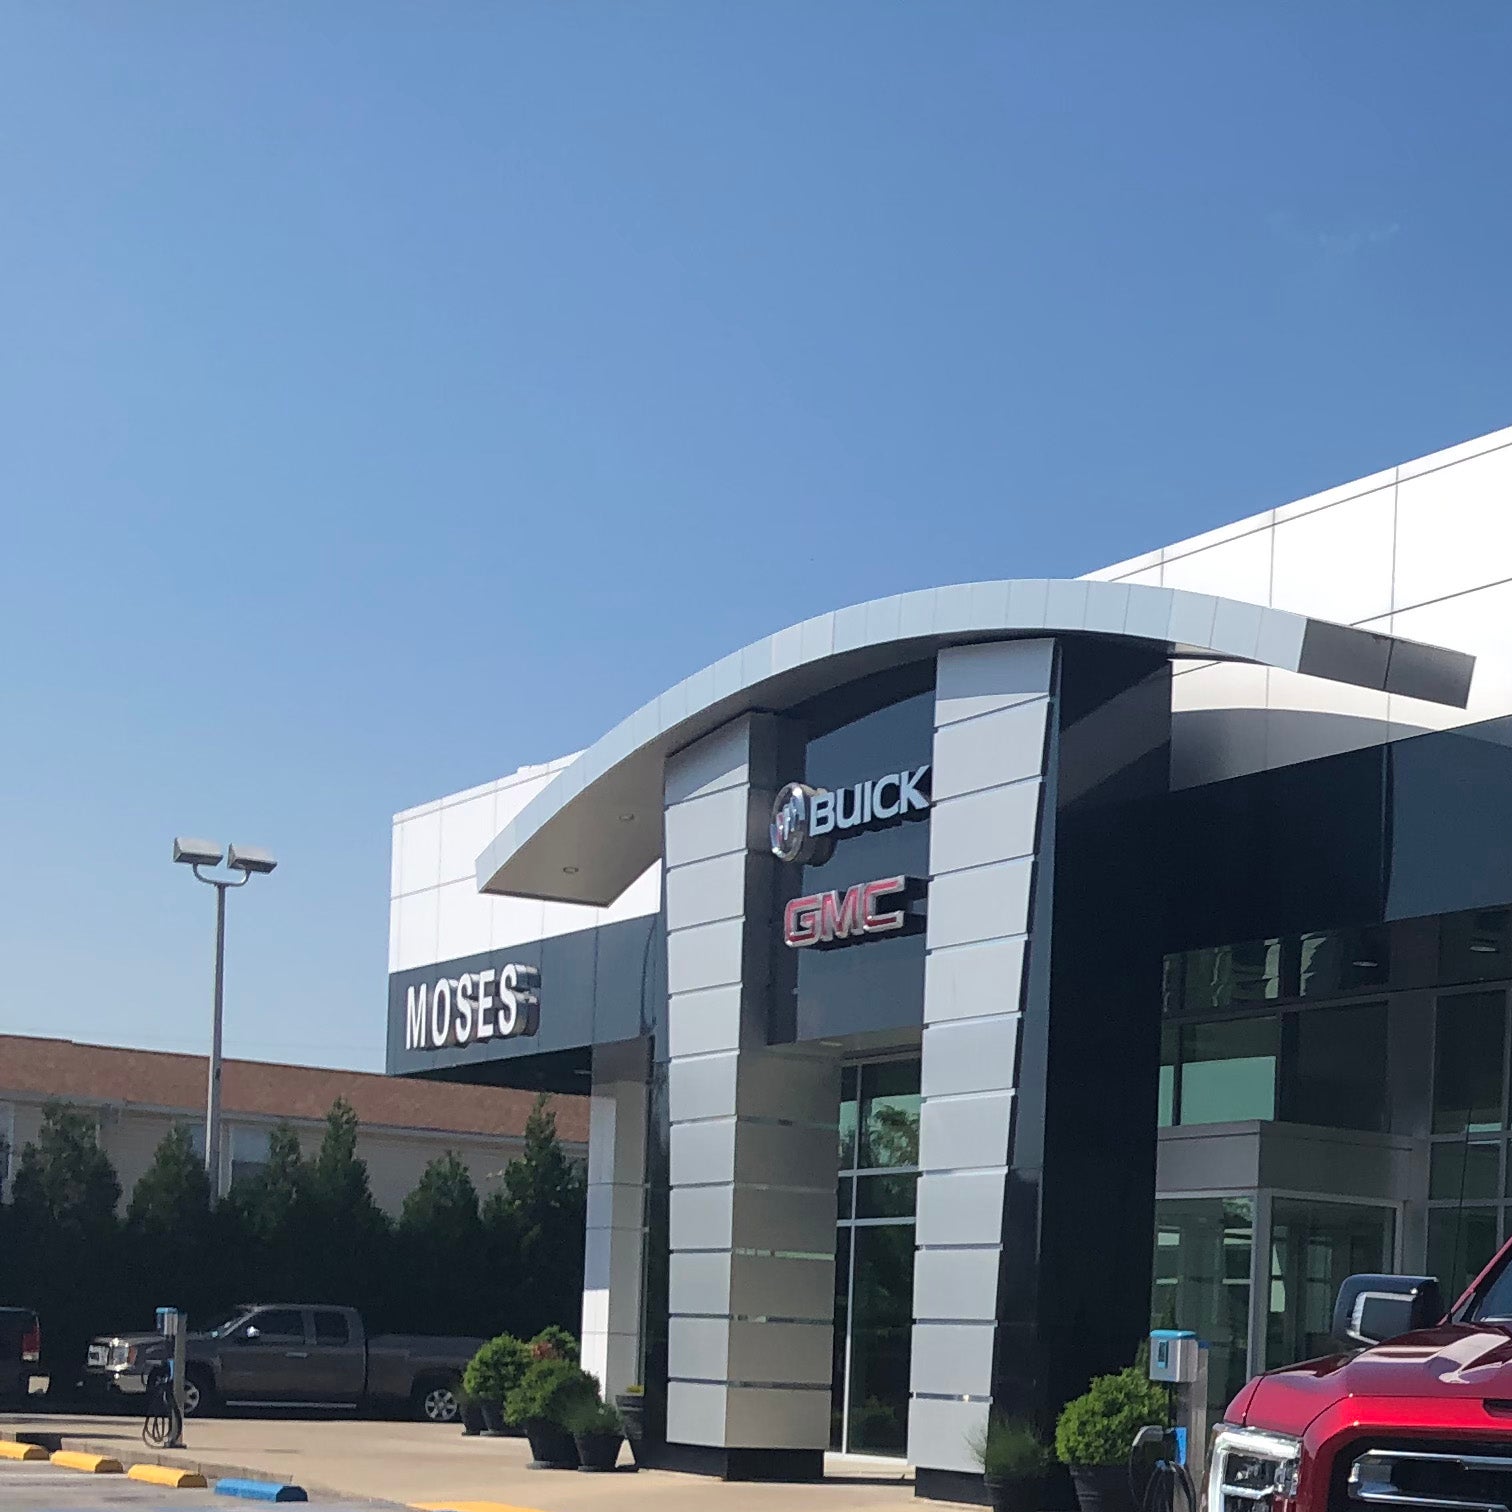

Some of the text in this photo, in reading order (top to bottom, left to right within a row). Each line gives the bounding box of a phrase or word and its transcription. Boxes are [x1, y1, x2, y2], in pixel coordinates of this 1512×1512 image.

[809, 765, 929, 837] BUICK
[784, 874, 905, 948] GMC
[405, 963, 522, 1050] MOSES
